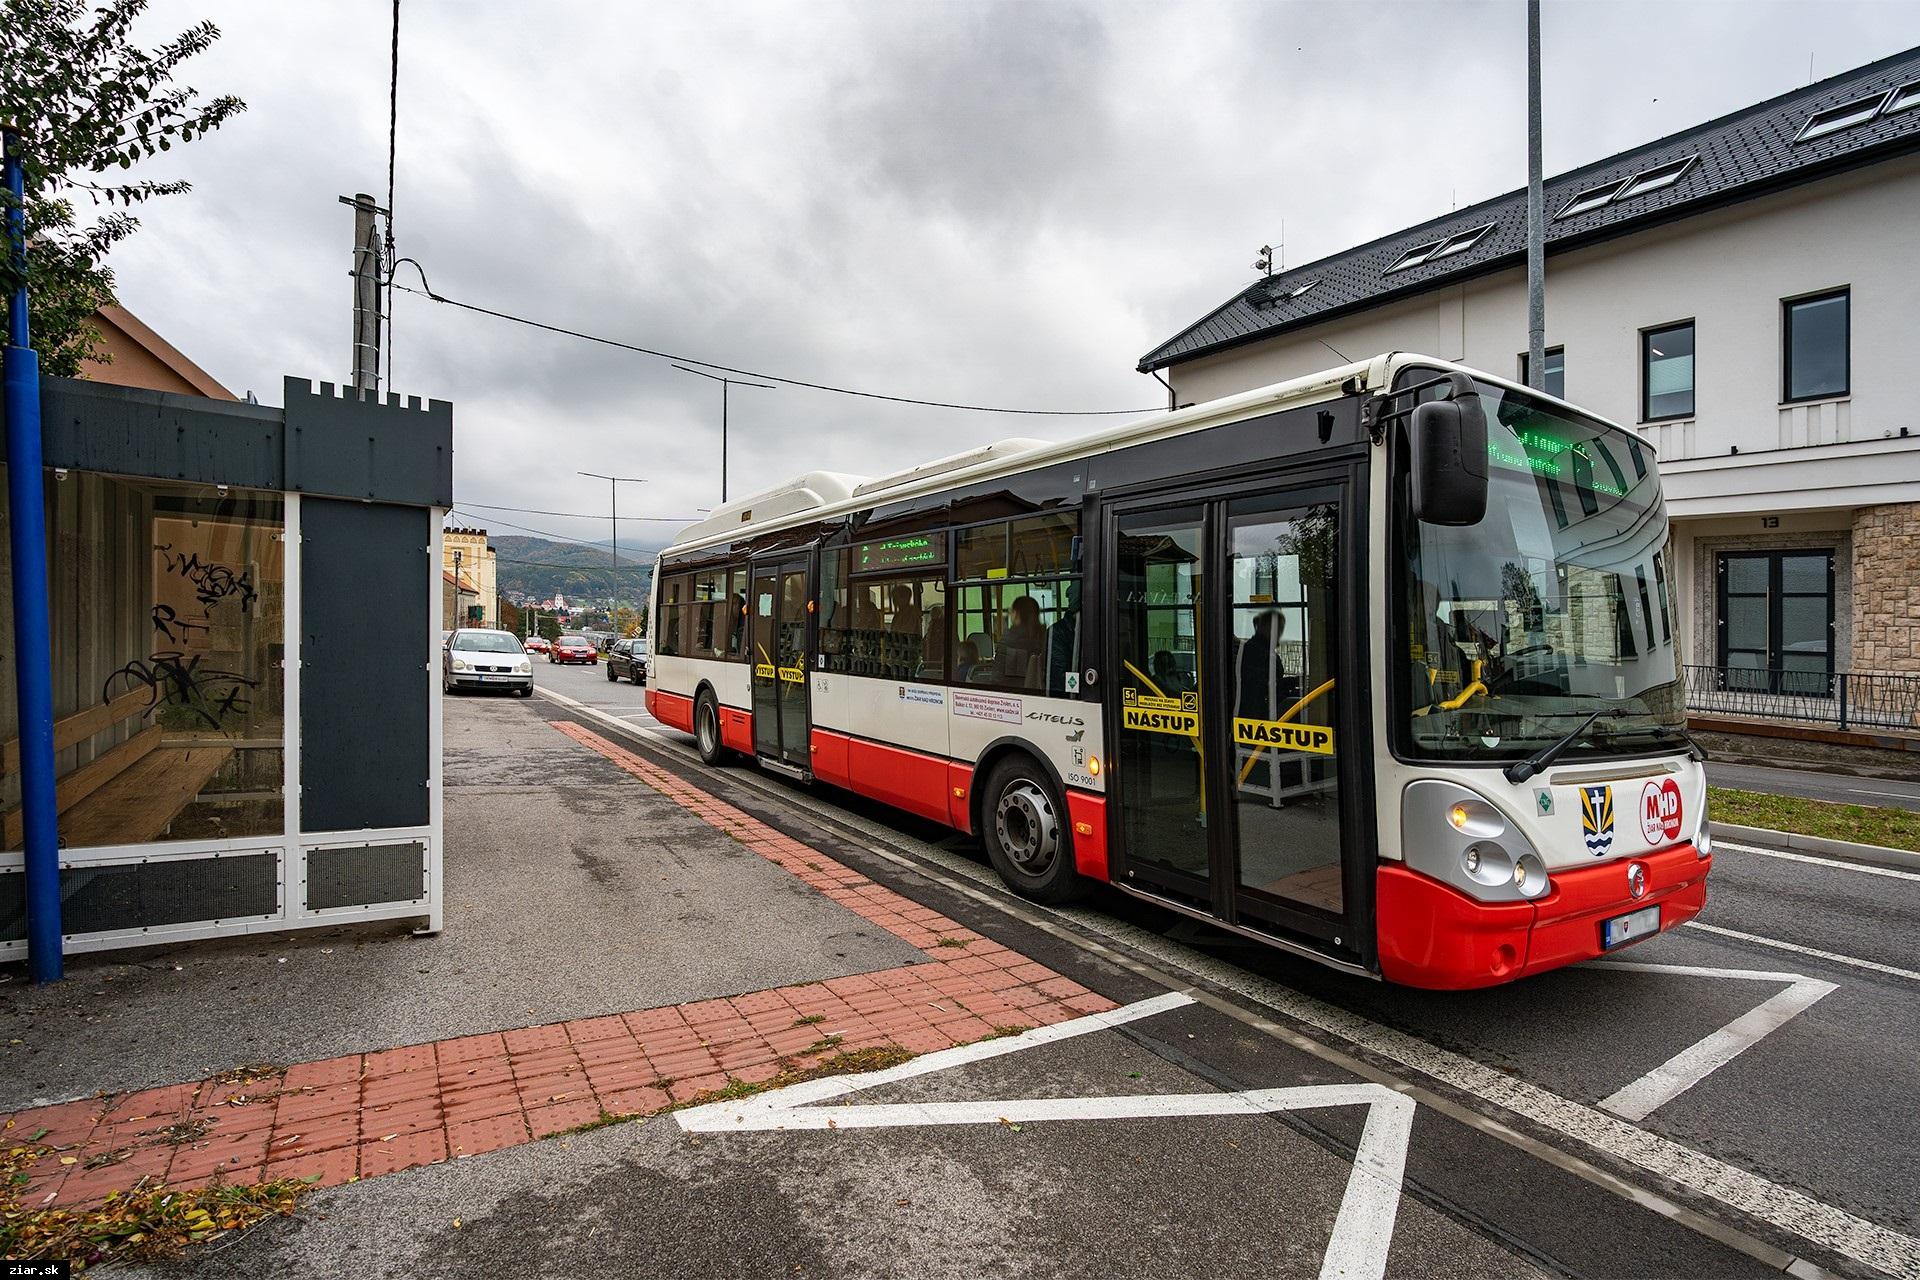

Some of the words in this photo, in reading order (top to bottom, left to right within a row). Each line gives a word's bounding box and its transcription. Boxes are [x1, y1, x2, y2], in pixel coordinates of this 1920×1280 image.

[1761, 517, 1779, 528] 13
[1127, 711, 1195, 731] NÁSTUP
[1238, 723, 1328, 748] NÁSTUP
[1068, 772, 1079, 782] ISO
[1081, 775, 1096, 785] 9001
[1647, 791, 1678, 819] MHD
